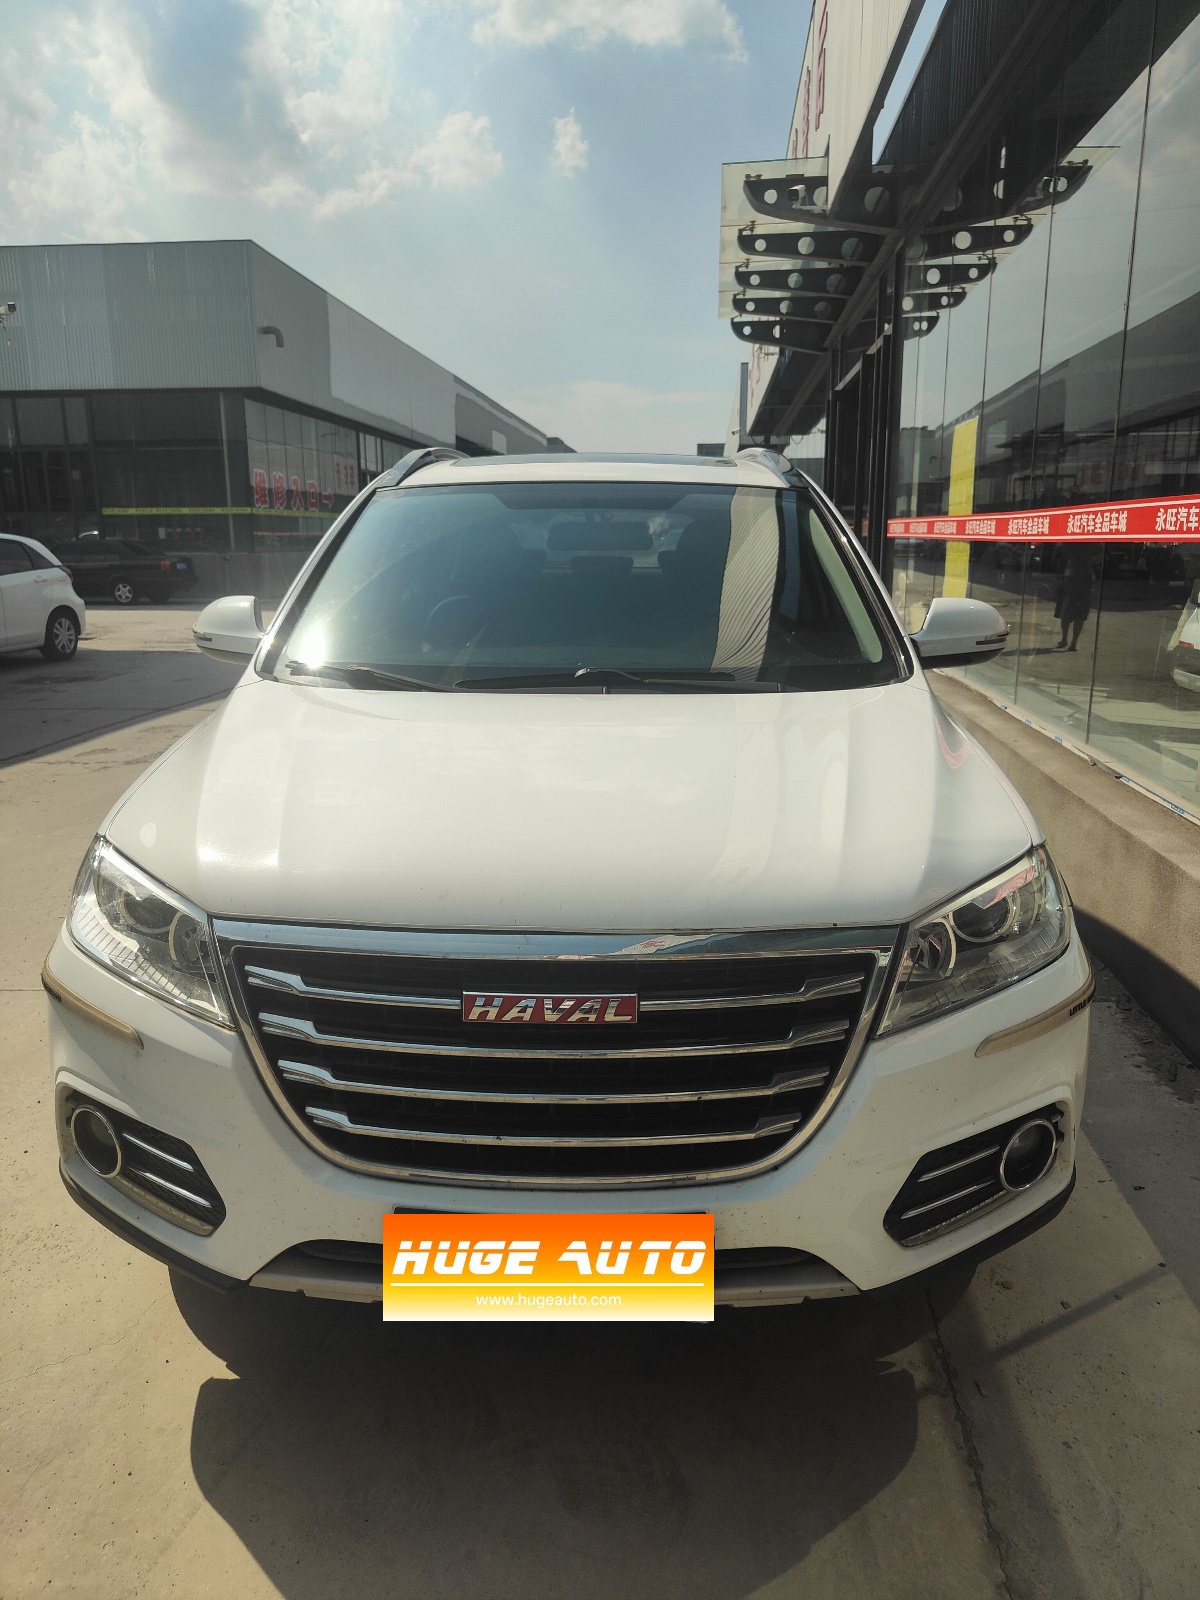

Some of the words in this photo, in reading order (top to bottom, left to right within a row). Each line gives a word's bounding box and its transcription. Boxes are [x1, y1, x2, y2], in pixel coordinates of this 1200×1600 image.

[1067, 511, 1128, 533] 永旺汽车全品车城
[468, 997, 633, 1022] HAVAL
